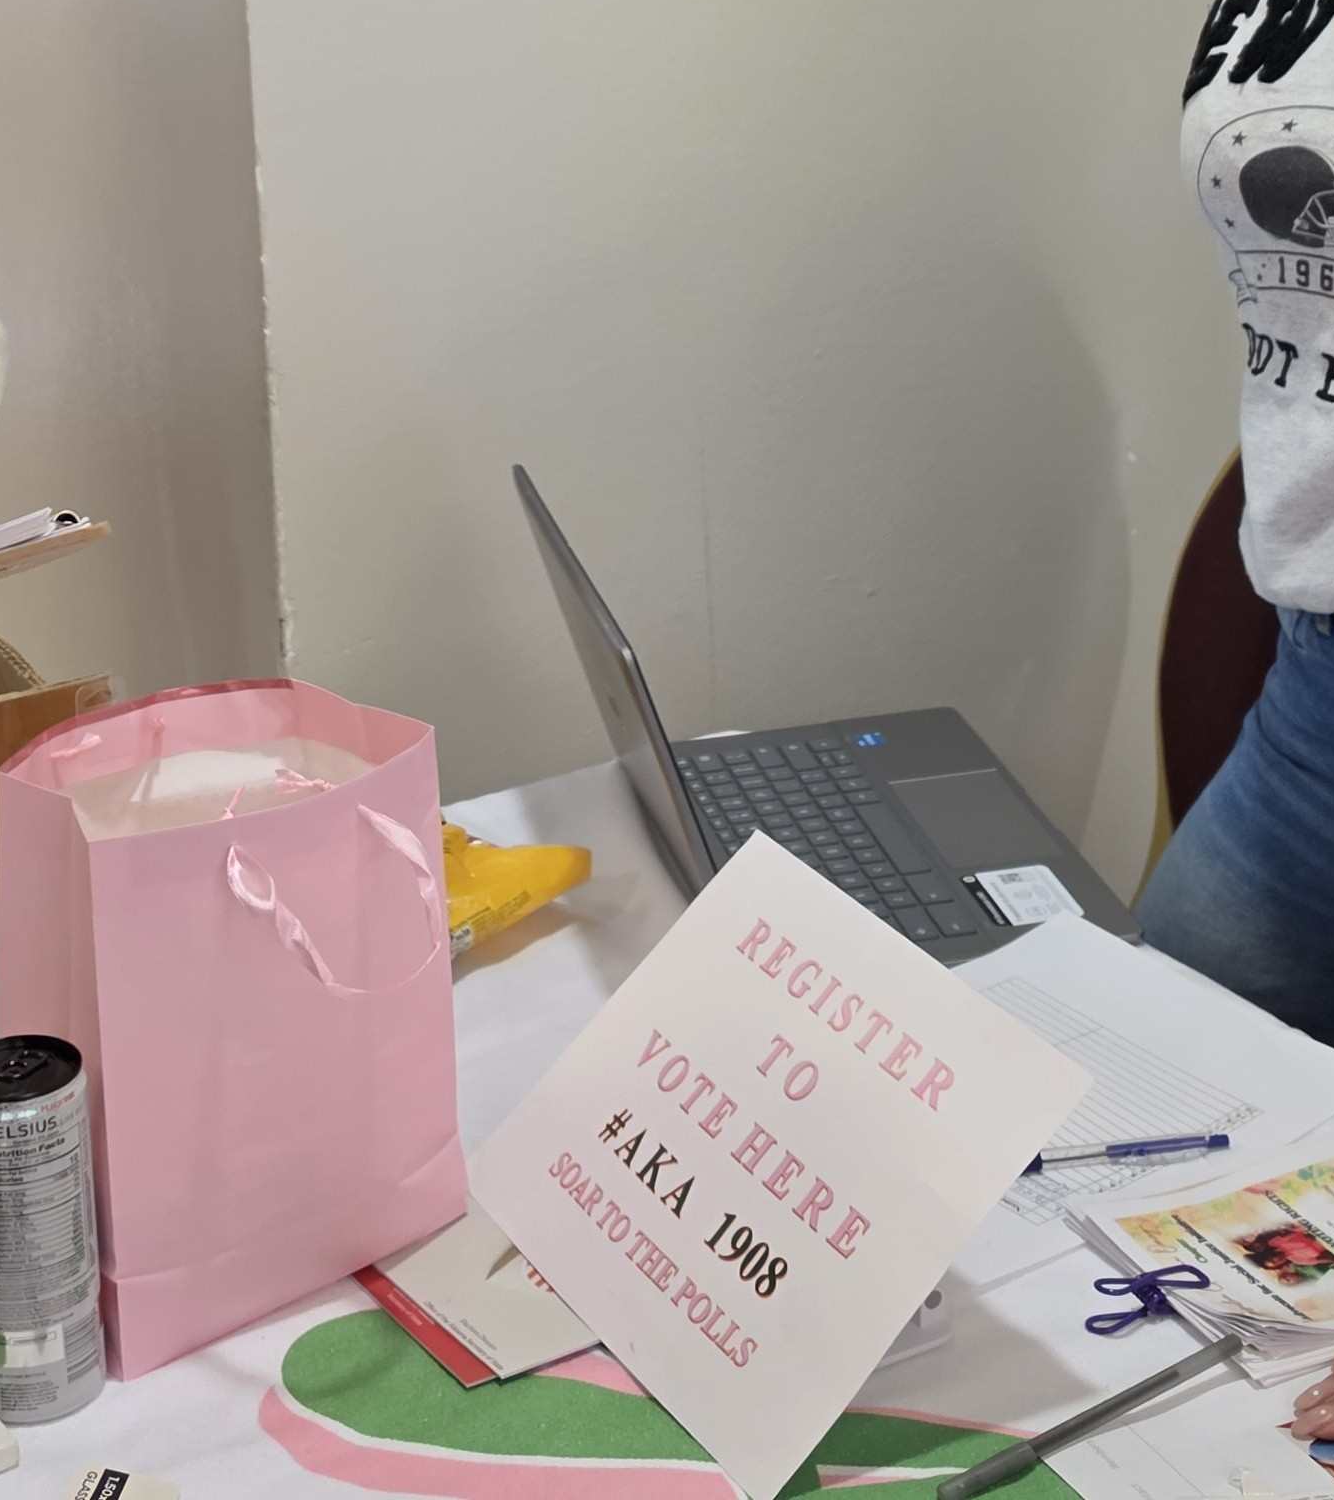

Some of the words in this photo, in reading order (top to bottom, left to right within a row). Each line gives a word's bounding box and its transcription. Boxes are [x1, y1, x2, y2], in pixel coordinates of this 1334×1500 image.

[735, 917, 956, 1112] REGISTER
[755, 1034, 820, 1102] TO
[38, 1138, 66, 1153] Facts
[597, 1108, 697, 1219] #AKA
[703, 1212, 790, 1298] 1908
[636, 1029, 738, 1139] VOTE
[730, 1122, 872, 1260] HERE
[1266, 1190, 1302, 1220] RIGHTS
[548, 1152, 604, 1217] SOAR
[596, 1204, 631, 1243] TO
[625, 1232, 679, 1293] THE
[670, 1283, 760, 1370] POLLS
[1231, 1263, 1260, 1285] Social
